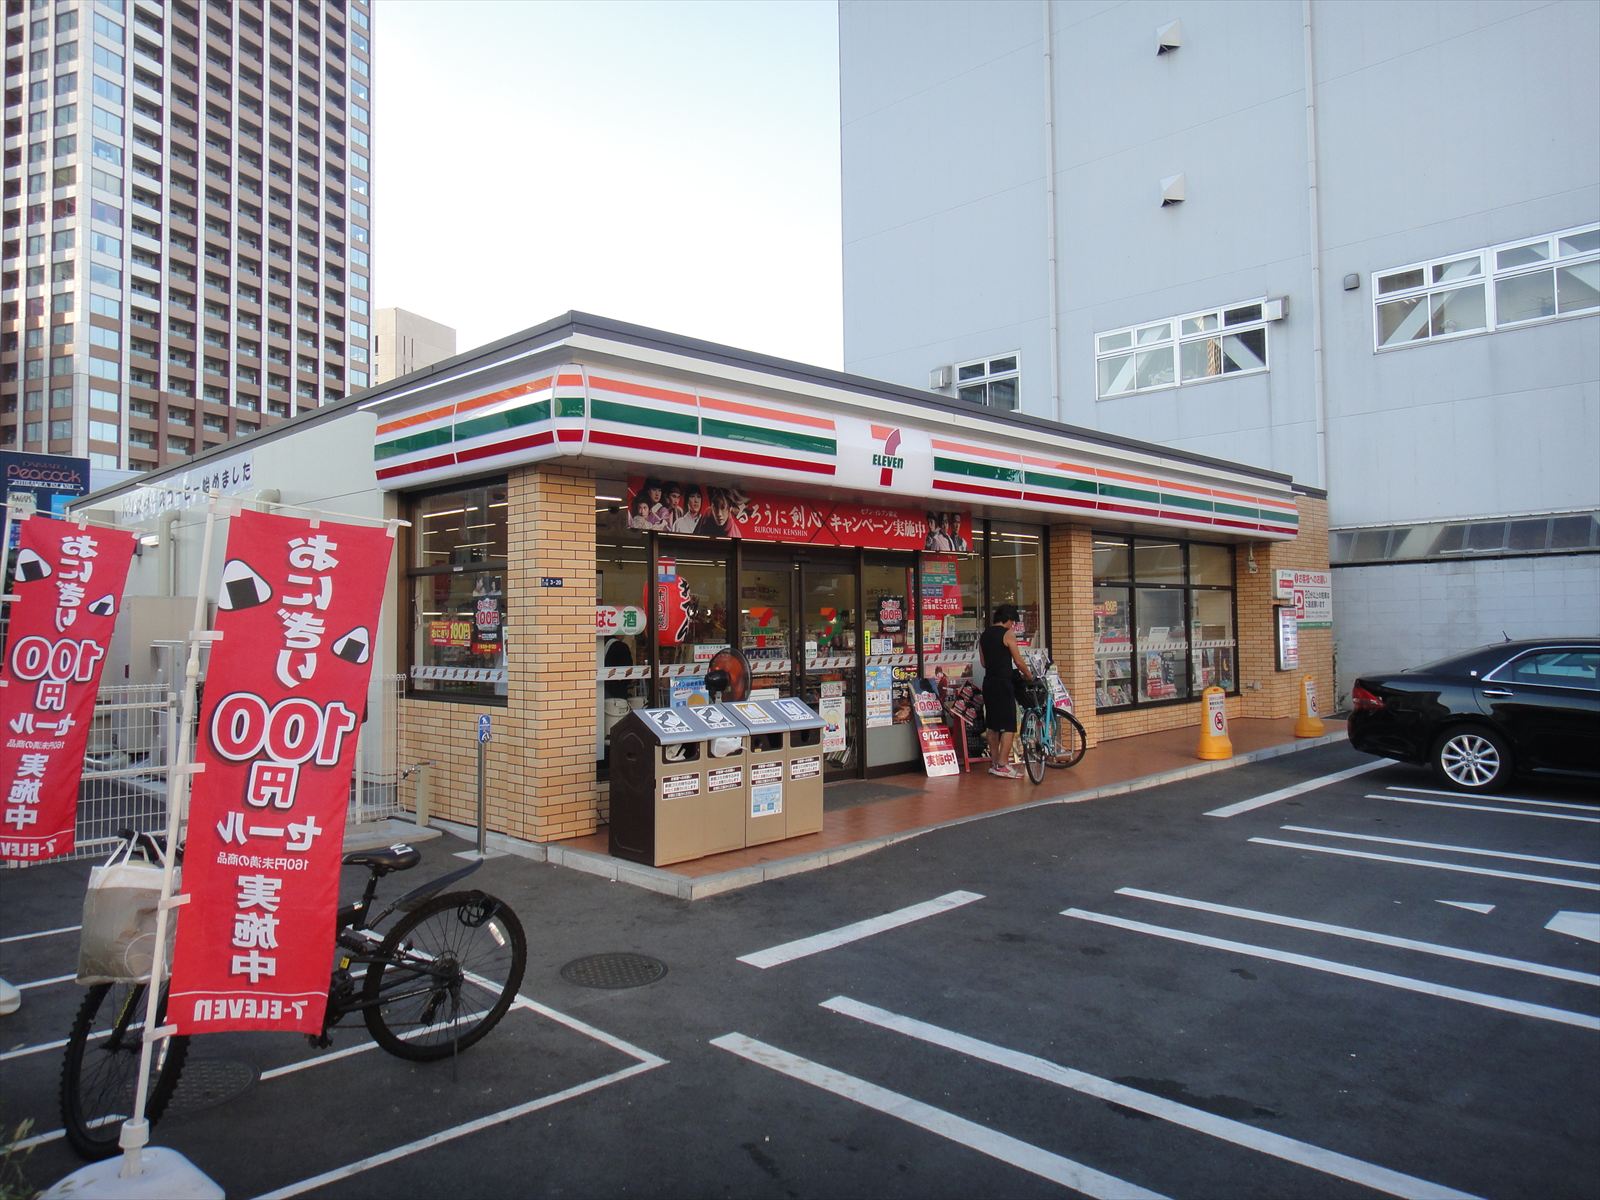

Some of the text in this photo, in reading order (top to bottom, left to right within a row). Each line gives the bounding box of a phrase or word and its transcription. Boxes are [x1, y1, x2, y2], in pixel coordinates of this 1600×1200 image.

[7, 464, 81, 483] Peacock
[736, 503, 823, 529] るろうに剣心
[754, 526, 808, 537] RUROUNI KENSHIN
[830, 513, 926, 538] キャンペーン実施中
[476, 611, 500, 625] 100円
[623, 610, 637, 627] 酒
[880, 609, 903, 621] 100円
[914, 700, 943, 713] 100円
[926, 753, 957, 767] 実施中!
